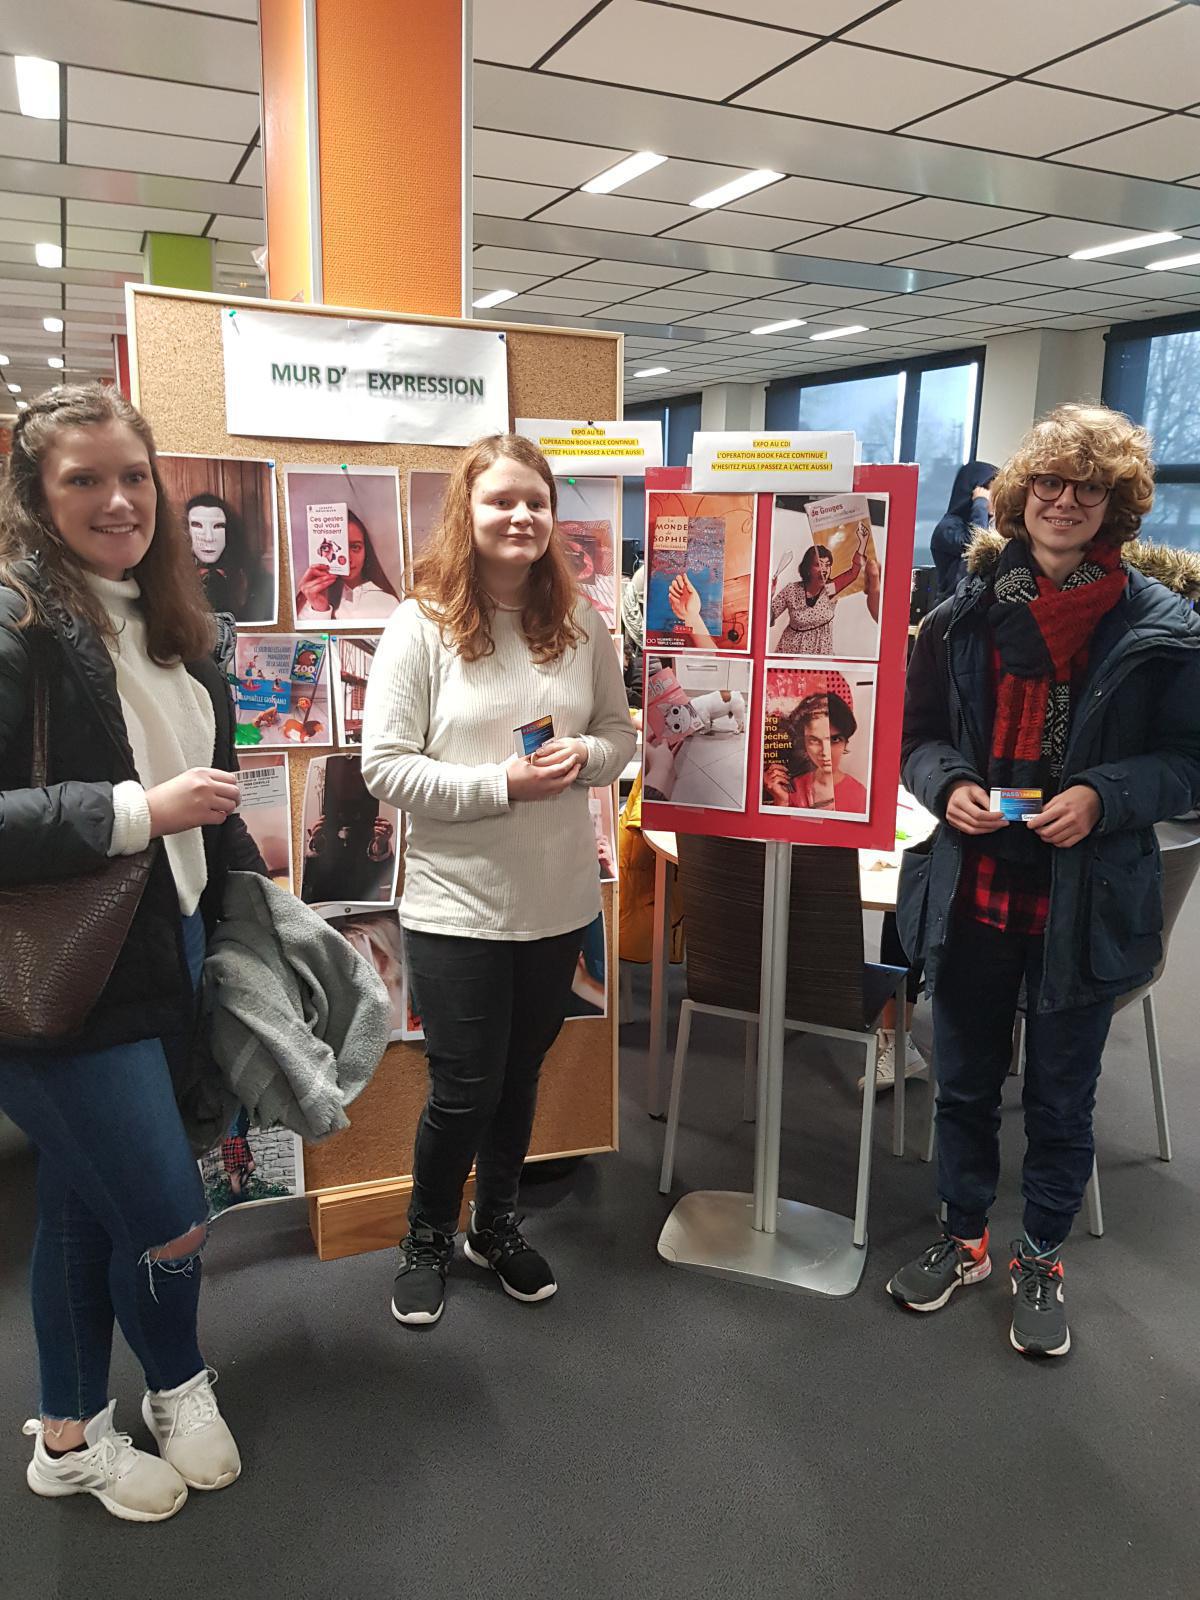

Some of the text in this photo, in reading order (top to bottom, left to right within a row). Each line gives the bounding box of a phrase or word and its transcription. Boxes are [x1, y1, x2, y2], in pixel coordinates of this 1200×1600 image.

[271, 363, 321, 385] MUR
[368, 371, 484, 396] EXPRESSION
[323, 515, 344, 523] gestes
[293, 664, 316, 674] ZOO
